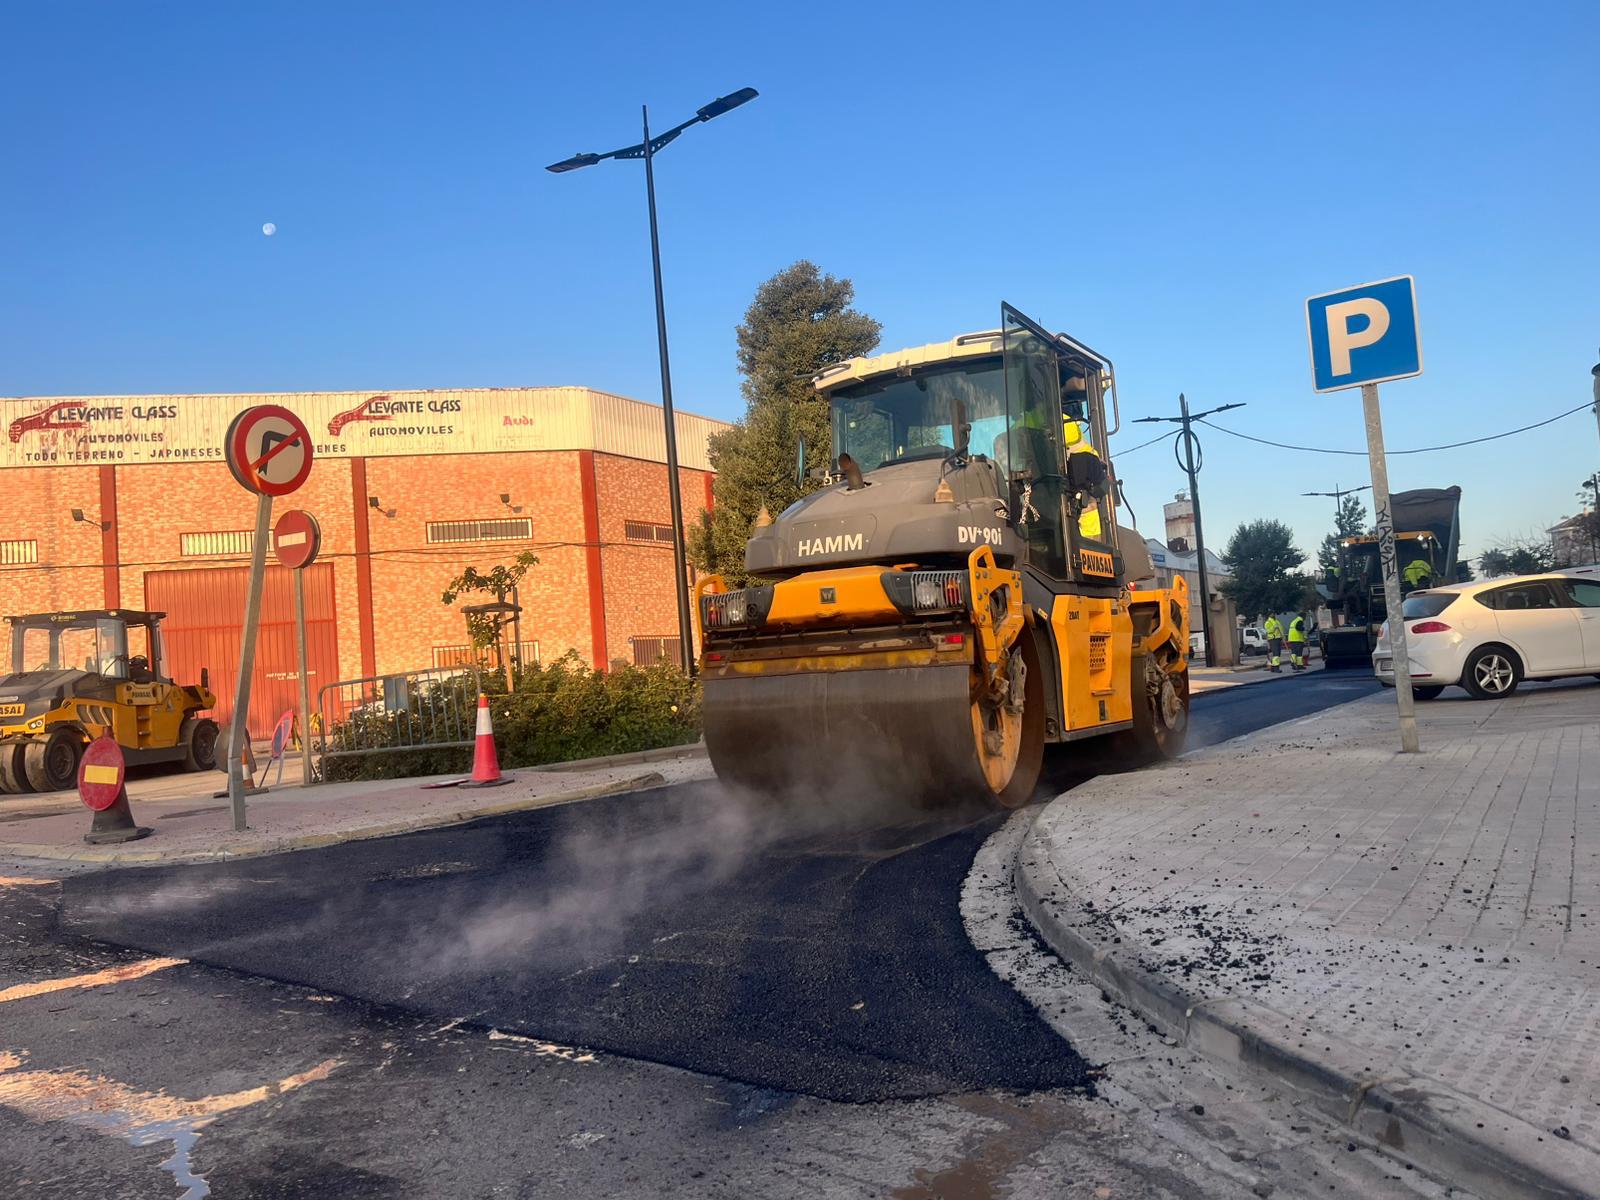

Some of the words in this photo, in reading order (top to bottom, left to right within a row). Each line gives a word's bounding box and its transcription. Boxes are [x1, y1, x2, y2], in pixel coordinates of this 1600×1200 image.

[1325, 297, 1391, 377] P
[57, 406, 123, 421] LEVANTE
[132, 405, 177, 421] CLASS
[368, 400, 423, 414] LEVANTE
[428, 400, 461, 413] CLASS
[502, 415, 534, 426] Audi
[78, 433, 164, 446] AUTOMOVILES
[369, 426, 454, 437] AUTOMOVILES
[26, 452, 58, 461] TODO
[67, 450, 124, 461] TERRENO
[150, 447, 222, 458] JAPONESES
[312, 444, 346, 453] ENES
[798, 533, 864, 557] HAMM
[1081, 553, 1113, 574] PAVASAL
